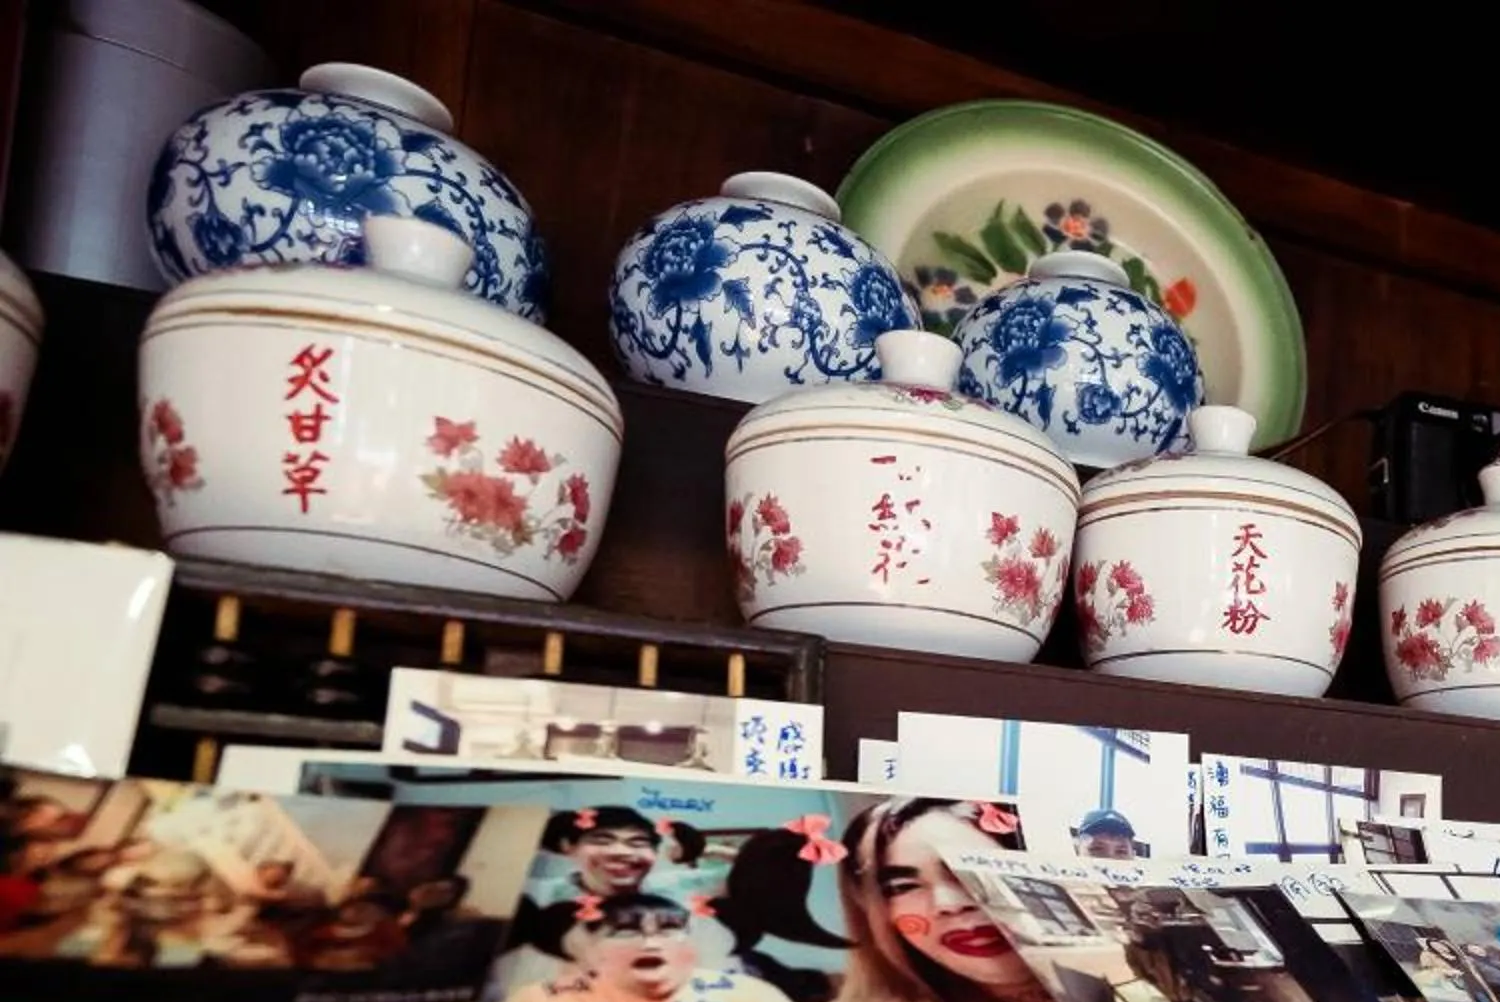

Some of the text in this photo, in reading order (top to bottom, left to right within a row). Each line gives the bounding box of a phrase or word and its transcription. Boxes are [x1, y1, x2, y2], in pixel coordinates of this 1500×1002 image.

[281, 343, 340, 515] 炙甘草
[1417, 400, 1460, 420] Canon
[1221, 523, 1271, 635] 天花粉
